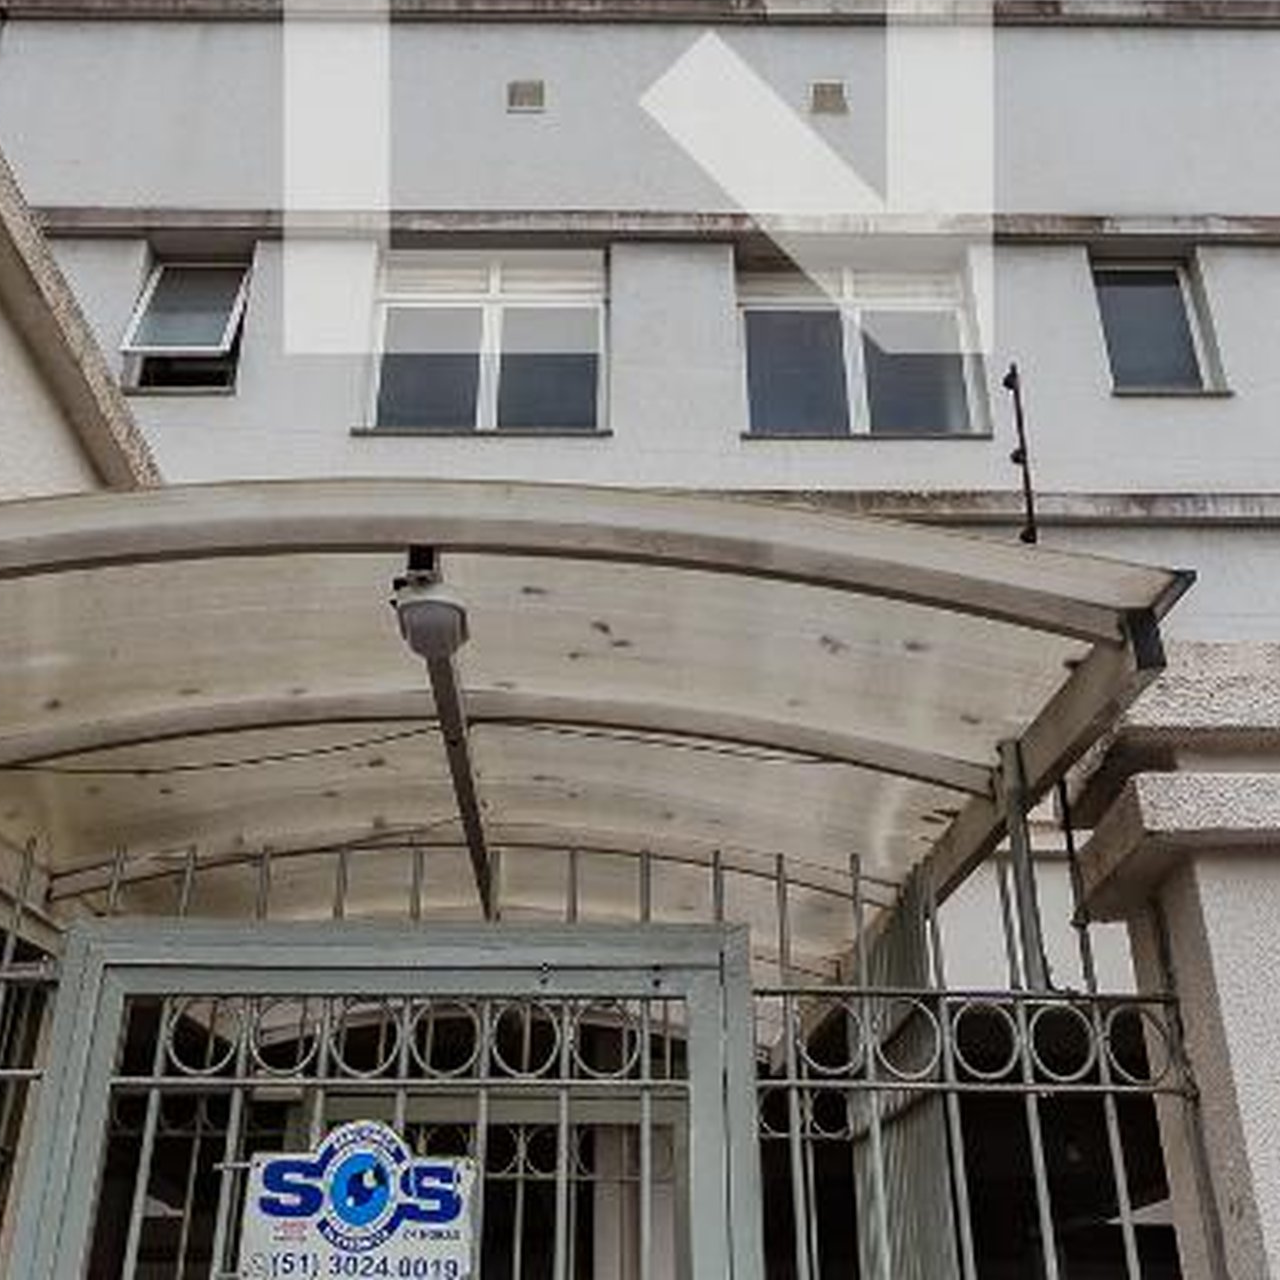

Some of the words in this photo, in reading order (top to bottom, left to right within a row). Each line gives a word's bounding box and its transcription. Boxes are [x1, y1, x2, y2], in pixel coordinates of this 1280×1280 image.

[258, 1128, 463, 1247] SOS
[271, 1252, 318, 1278] (51)
[329, 1255, 459, 1279] 3024.0019
